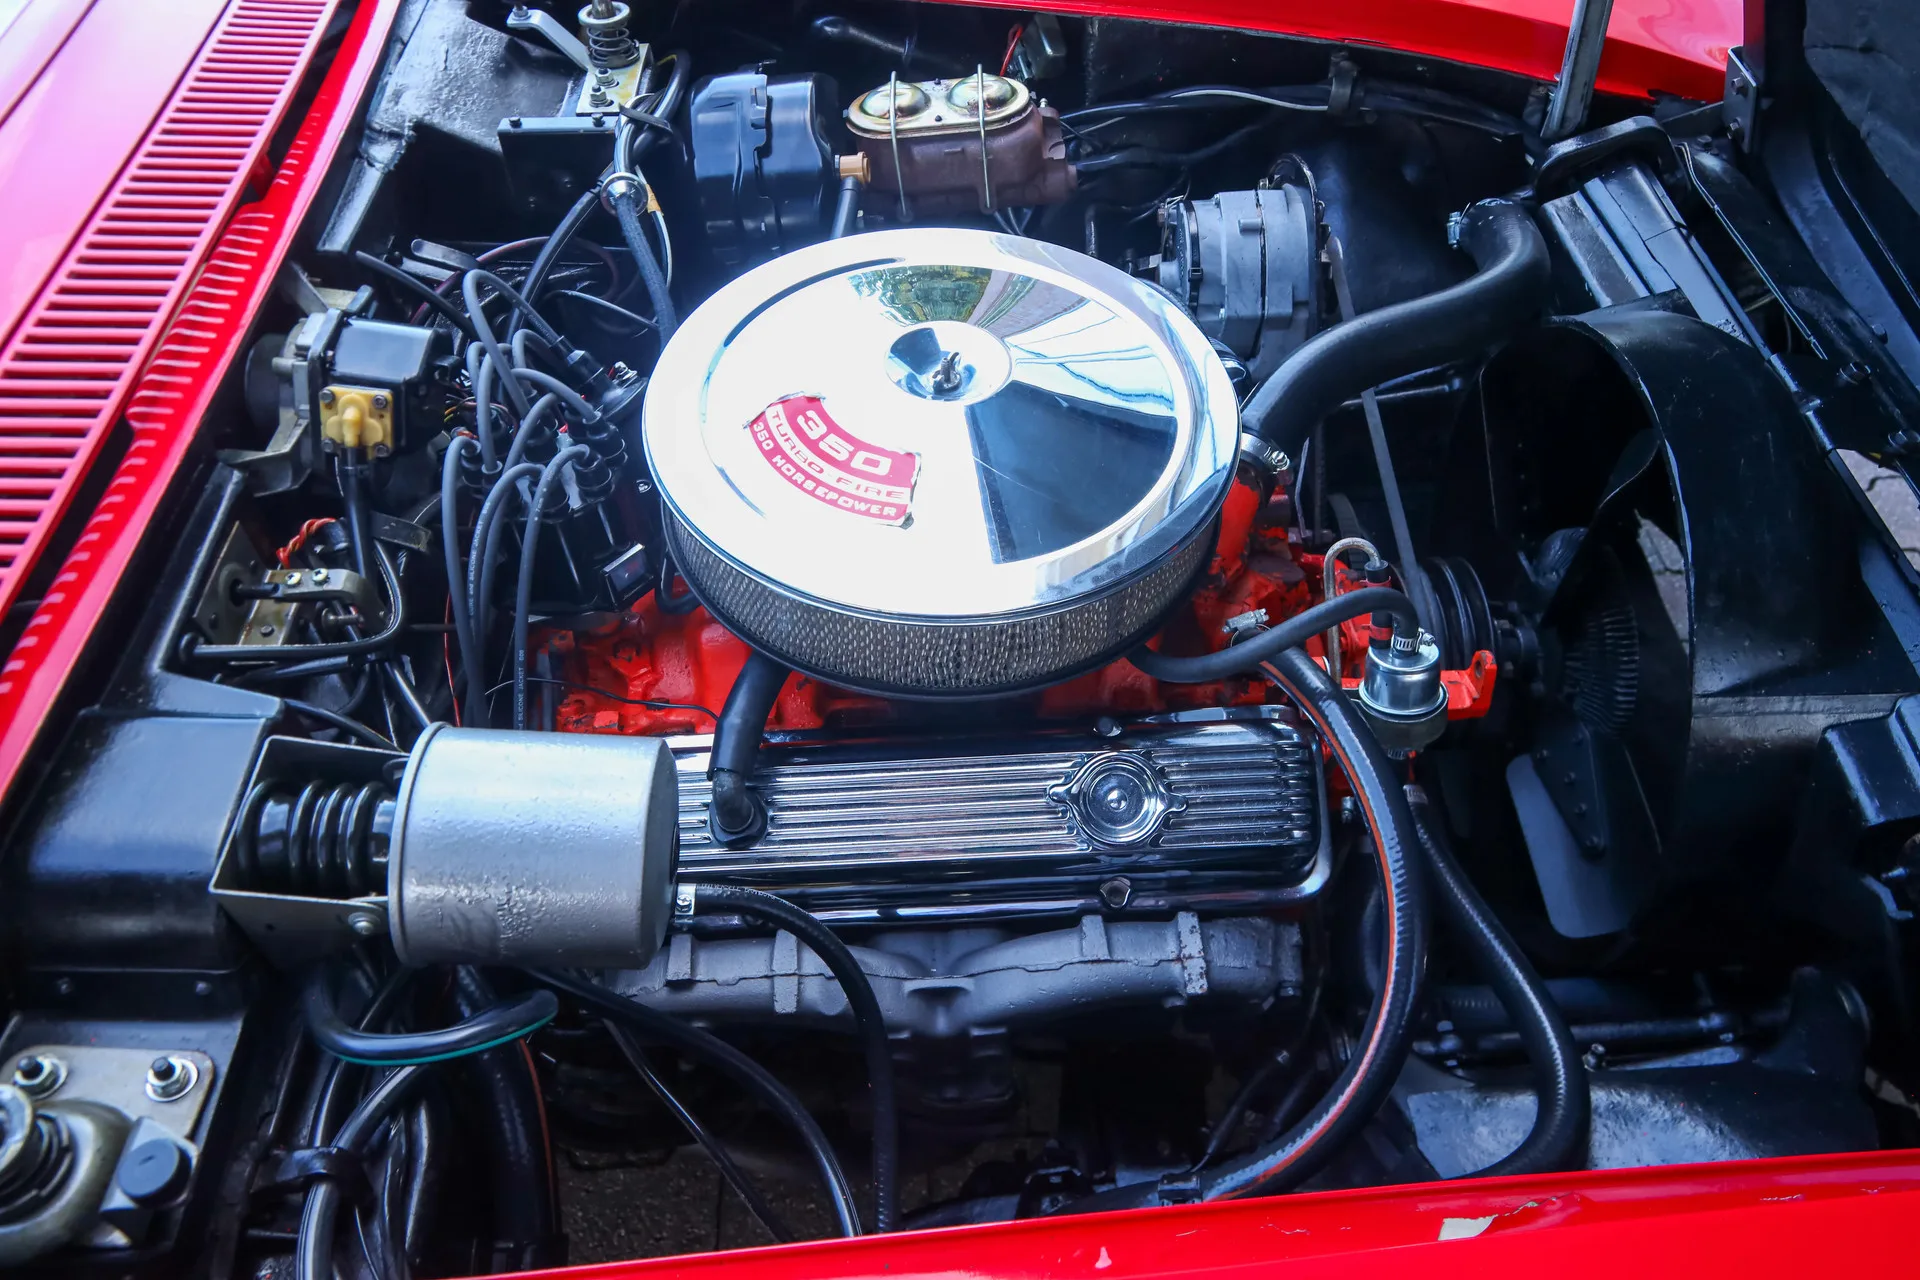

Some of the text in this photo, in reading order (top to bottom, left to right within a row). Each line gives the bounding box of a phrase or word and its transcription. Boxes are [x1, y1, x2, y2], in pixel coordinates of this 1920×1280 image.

[753, 421, 898, 517] 350 HORSEPOWER
[796, 409, 892, 476] 350
[469, 551, 477, 581] SILICONE
[473, 521, 484, 547] JACKET
